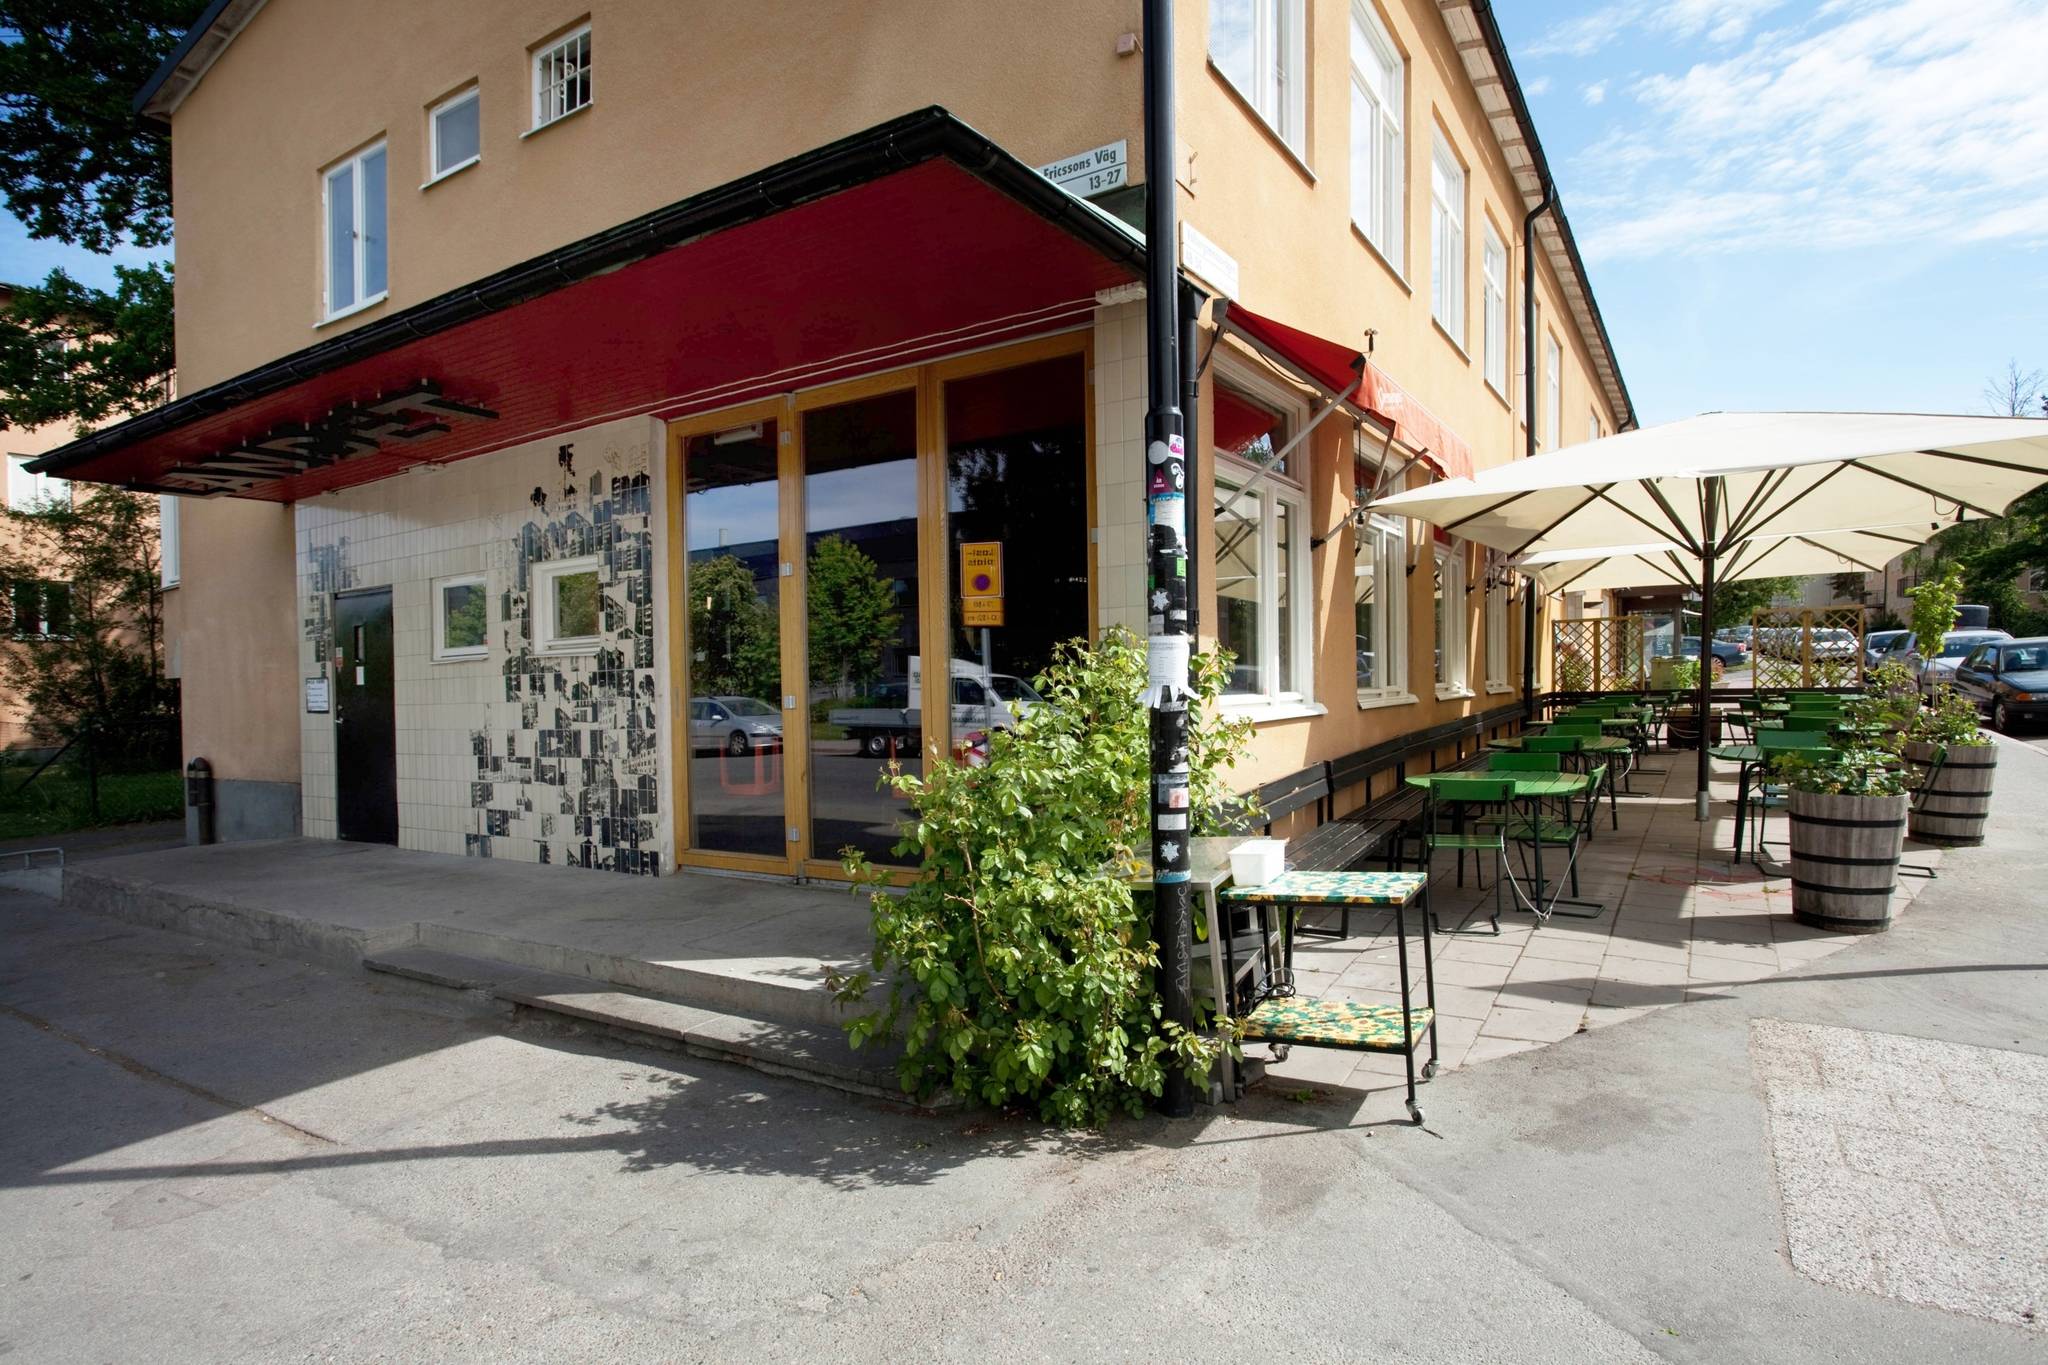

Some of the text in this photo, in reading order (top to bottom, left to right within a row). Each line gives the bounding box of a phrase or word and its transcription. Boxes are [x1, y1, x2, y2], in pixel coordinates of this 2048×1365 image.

[1043, 149, 1117, 180] Ericssons Väg
[1089, 168, 1121, 190] 13-27
